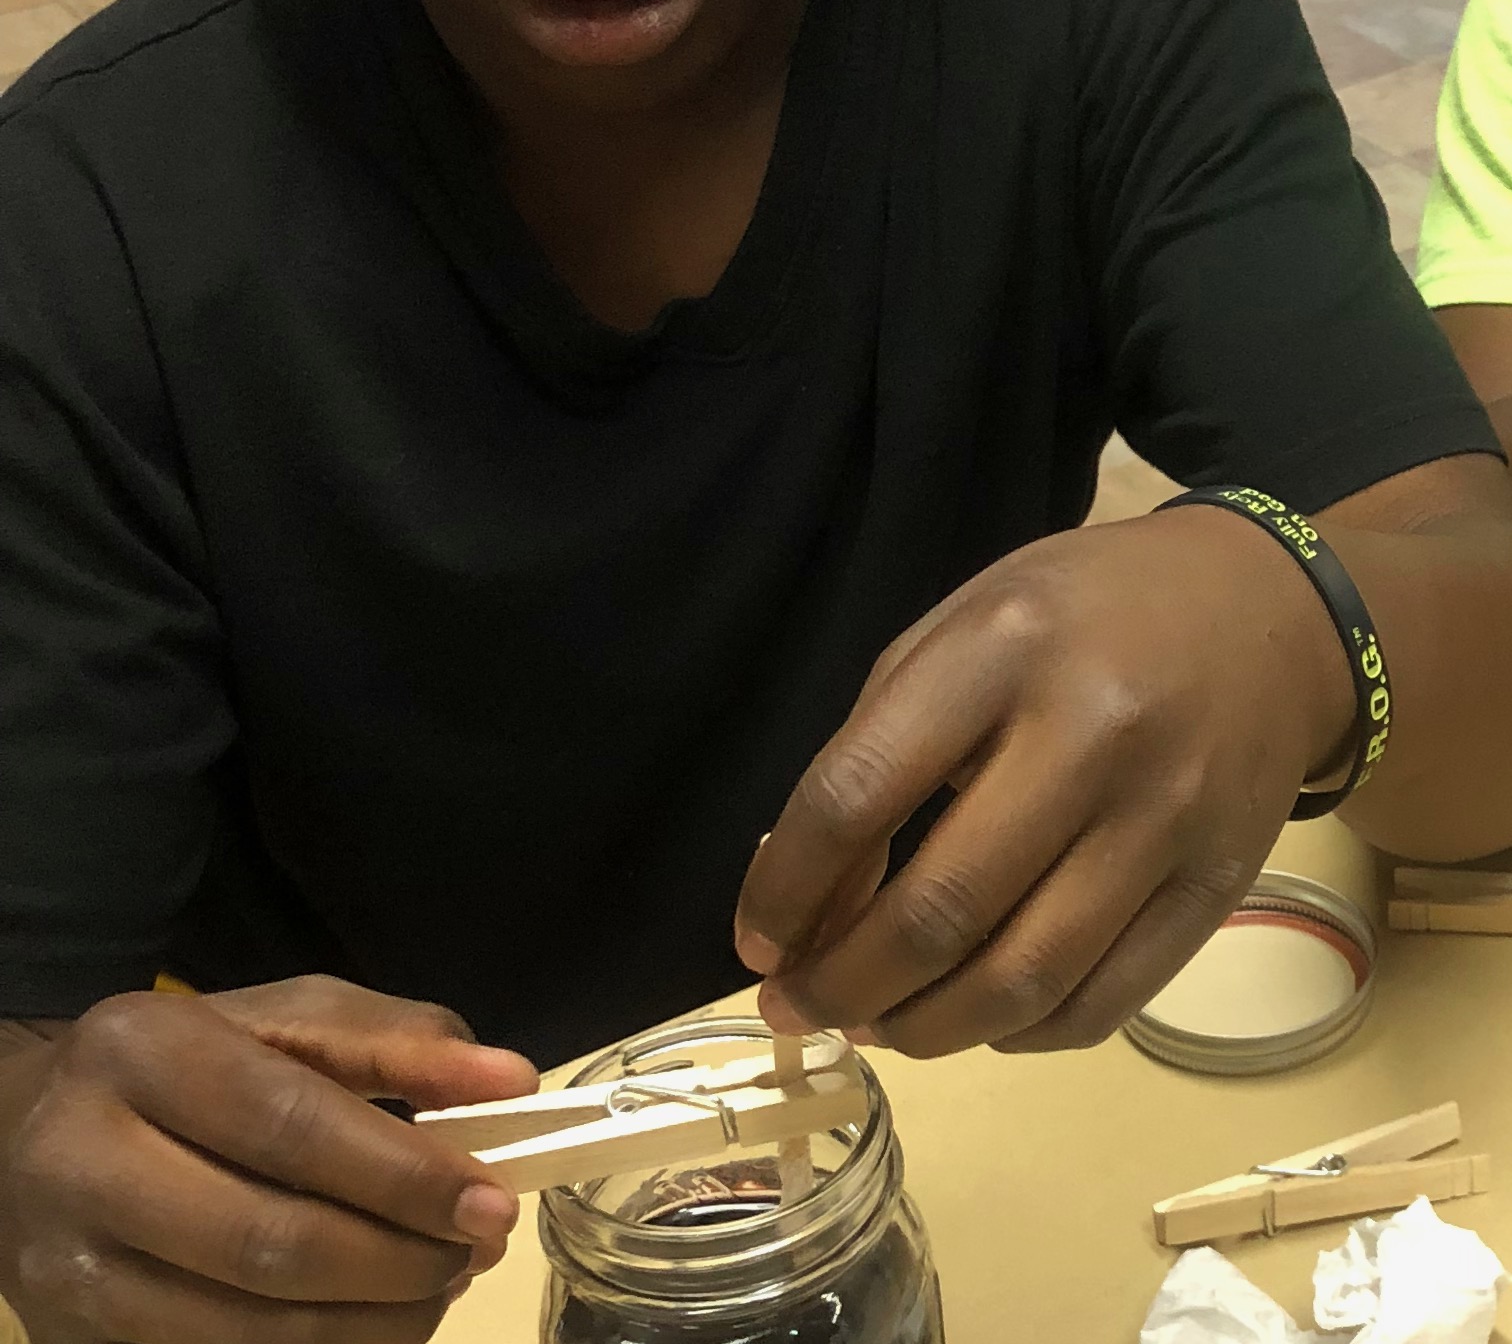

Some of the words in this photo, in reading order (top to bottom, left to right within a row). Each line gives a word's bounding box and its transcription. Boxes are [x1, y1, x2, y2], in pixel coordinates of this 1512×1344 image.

[1239, 486, 1286, 511] God
[1272, 515, 1317, 560] Fully
[1290, 512, 1319, 542] On
